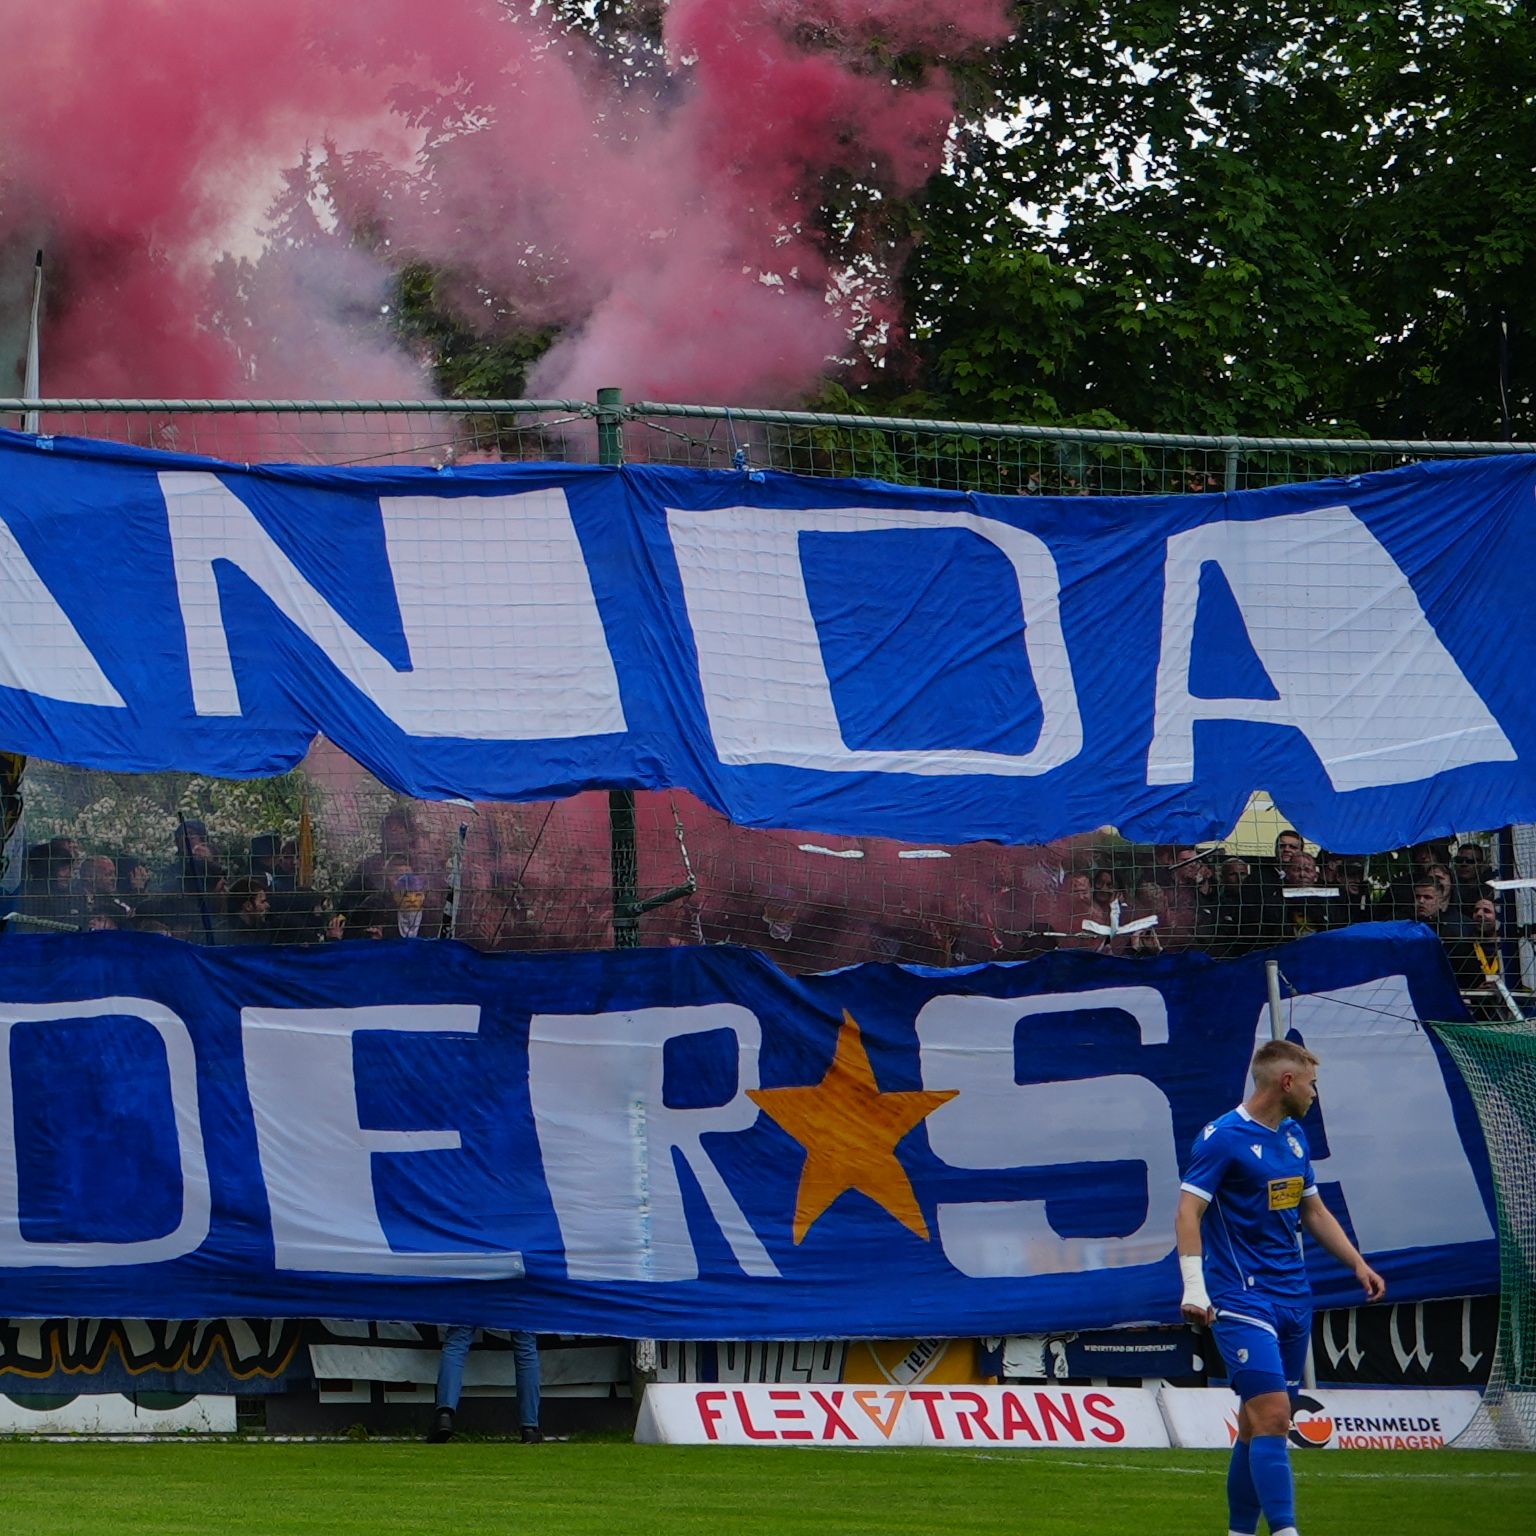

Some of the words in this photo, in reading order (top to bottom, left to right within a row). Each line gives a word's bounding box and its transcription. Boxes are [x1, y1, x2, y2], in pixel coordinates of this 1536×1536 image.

[914, 975, 1496, 1279] SA
[695, 1390, 859, 1441] FLEX
[909, 1390, 1126, 1443] TRANS
[1334, 1416, 1441, 1433] FERNMELDE
[1337, 1435, 1445, 1450] MONTAGEN
